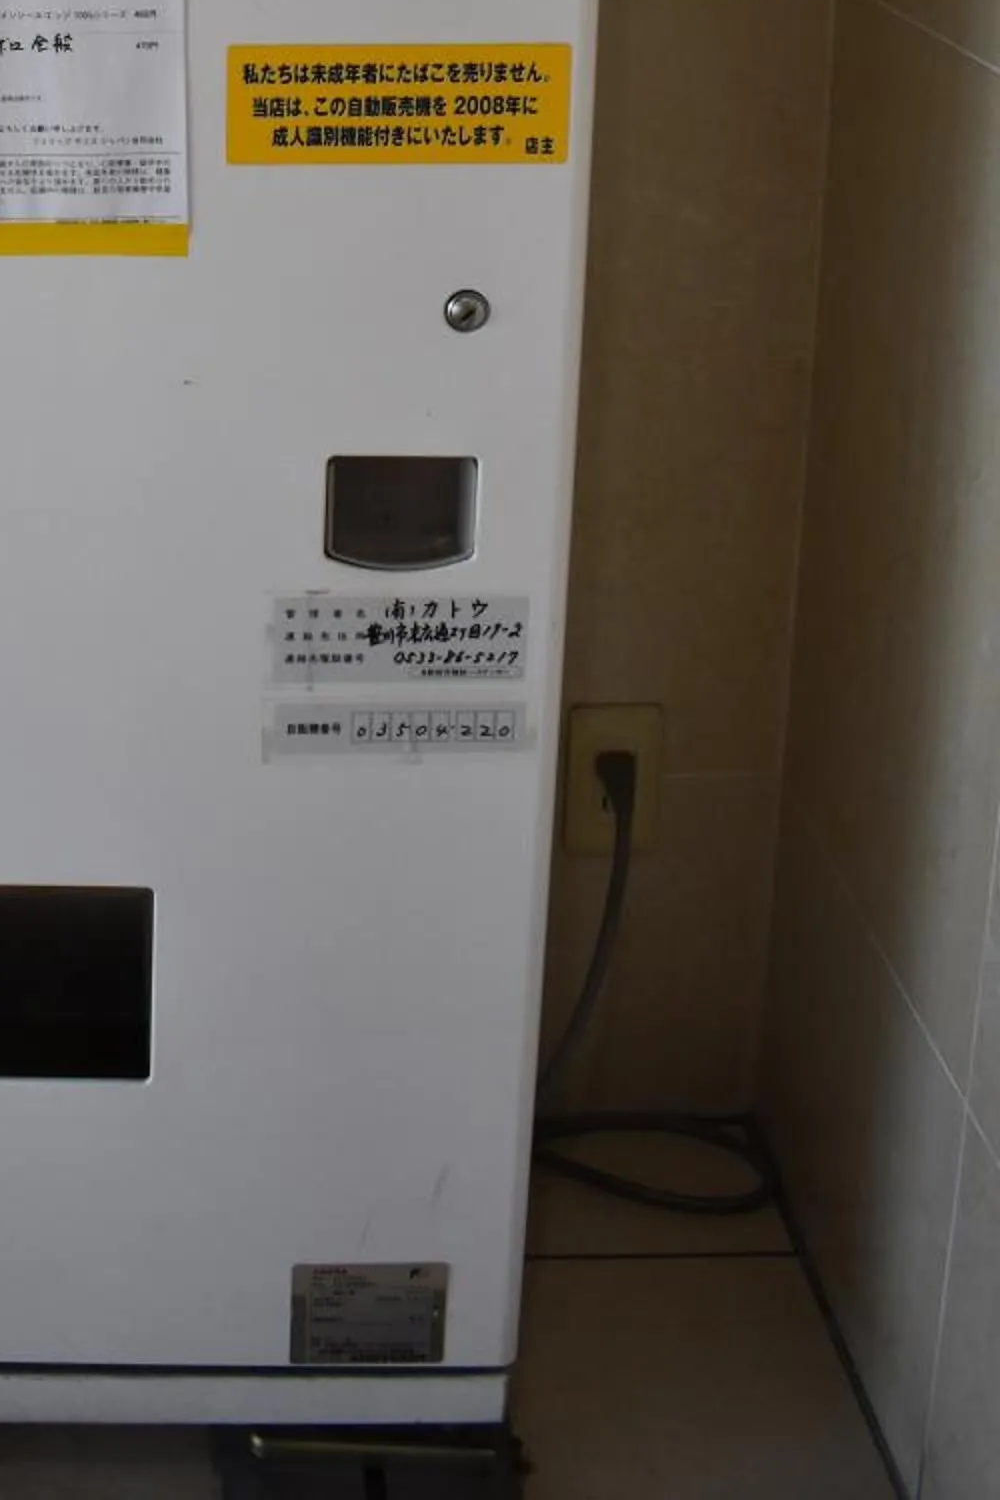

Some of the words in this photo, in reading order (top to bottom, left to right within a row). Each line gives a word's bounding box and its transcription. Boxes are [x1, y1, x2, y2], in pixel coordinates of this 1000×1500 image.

[242, 63, 549, 85] 私たちは未成年者にたばこを売りません。
[253, 97, 447, 118] 当店は、この自動販売機を
[454, 96, 537, 115] 2008年に
[271, 125, 511, 147] 成人識別機能付きにいたします。
[525, 138, 554, 154] 店主
